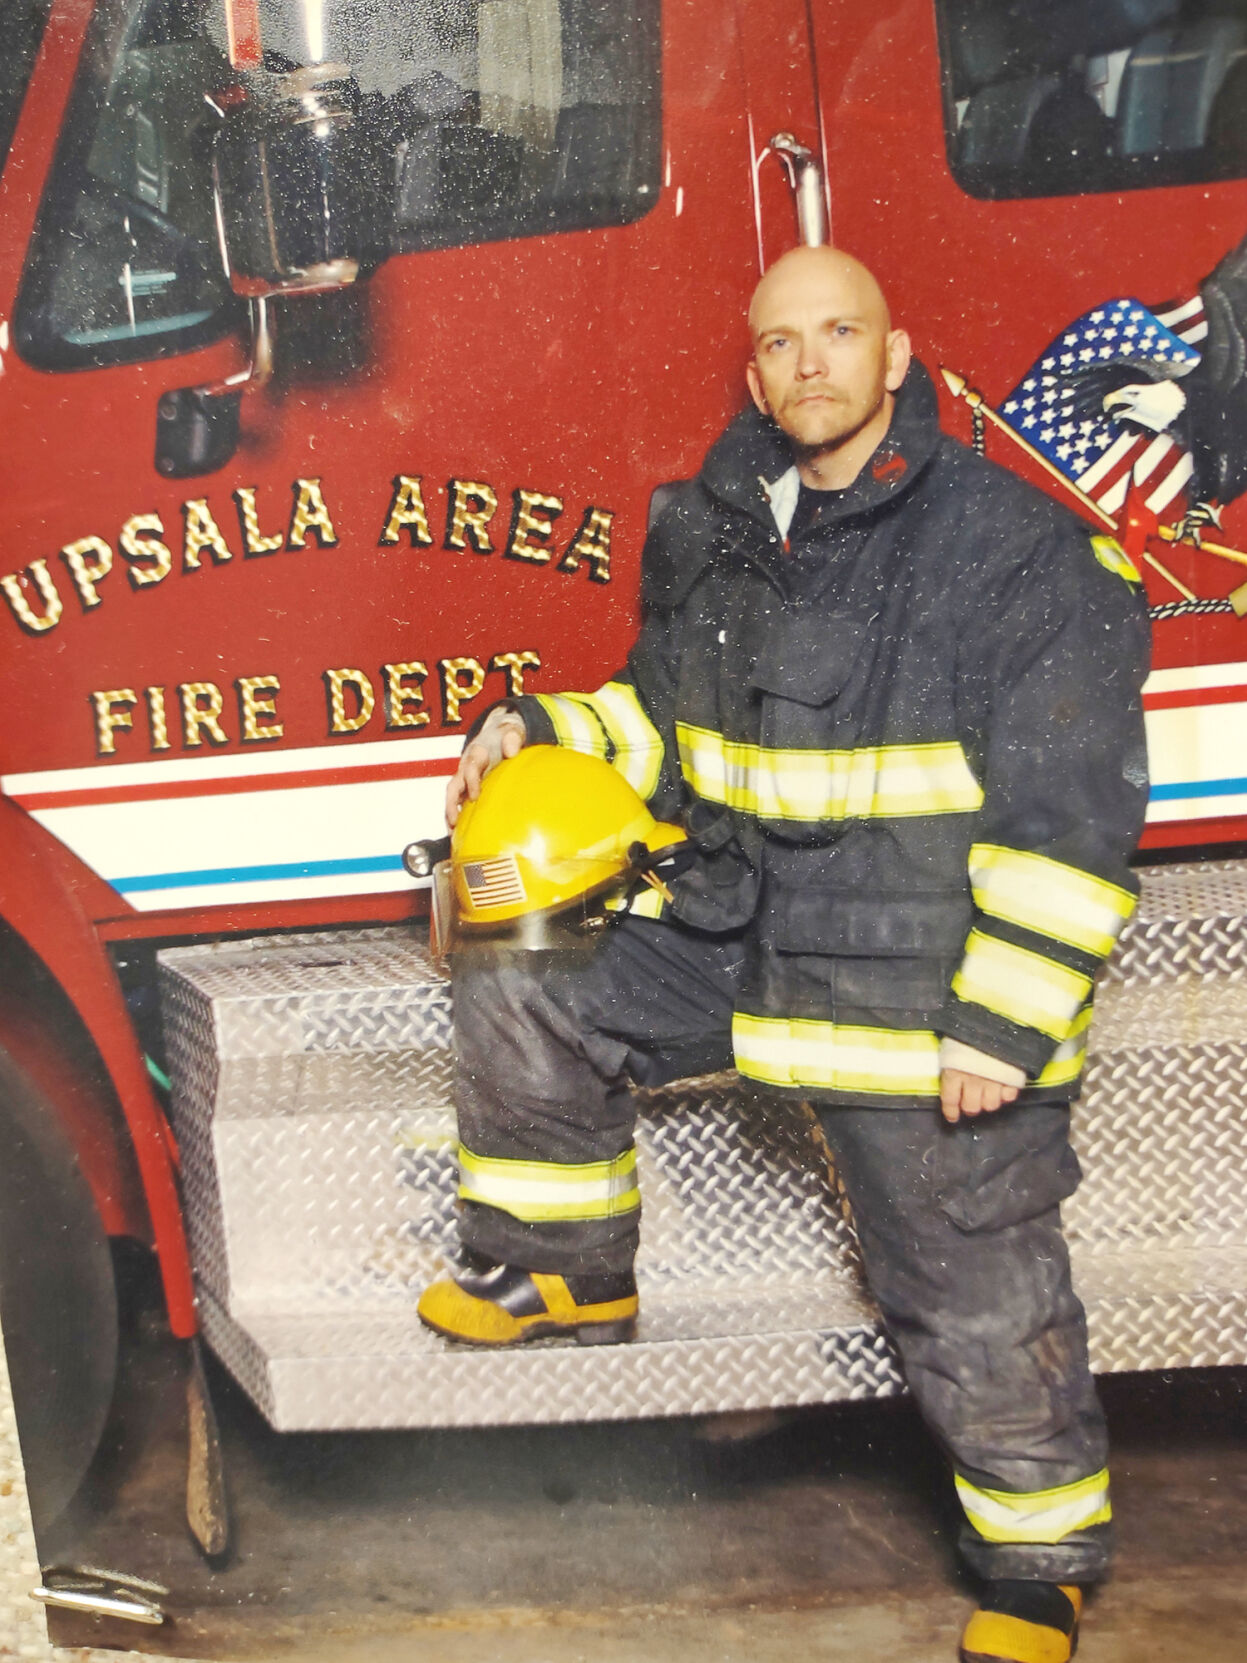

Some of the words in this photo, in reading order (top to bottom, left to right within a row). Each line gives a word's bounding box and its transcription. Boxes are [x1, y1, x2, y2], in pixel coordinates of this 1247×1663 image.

[1, 477, 338, 635] UPSALA
[382, 476, 614, 582] AREA
[92, 675, 285, 754] FIRE
[324, 651, 541, 735] DEPT
